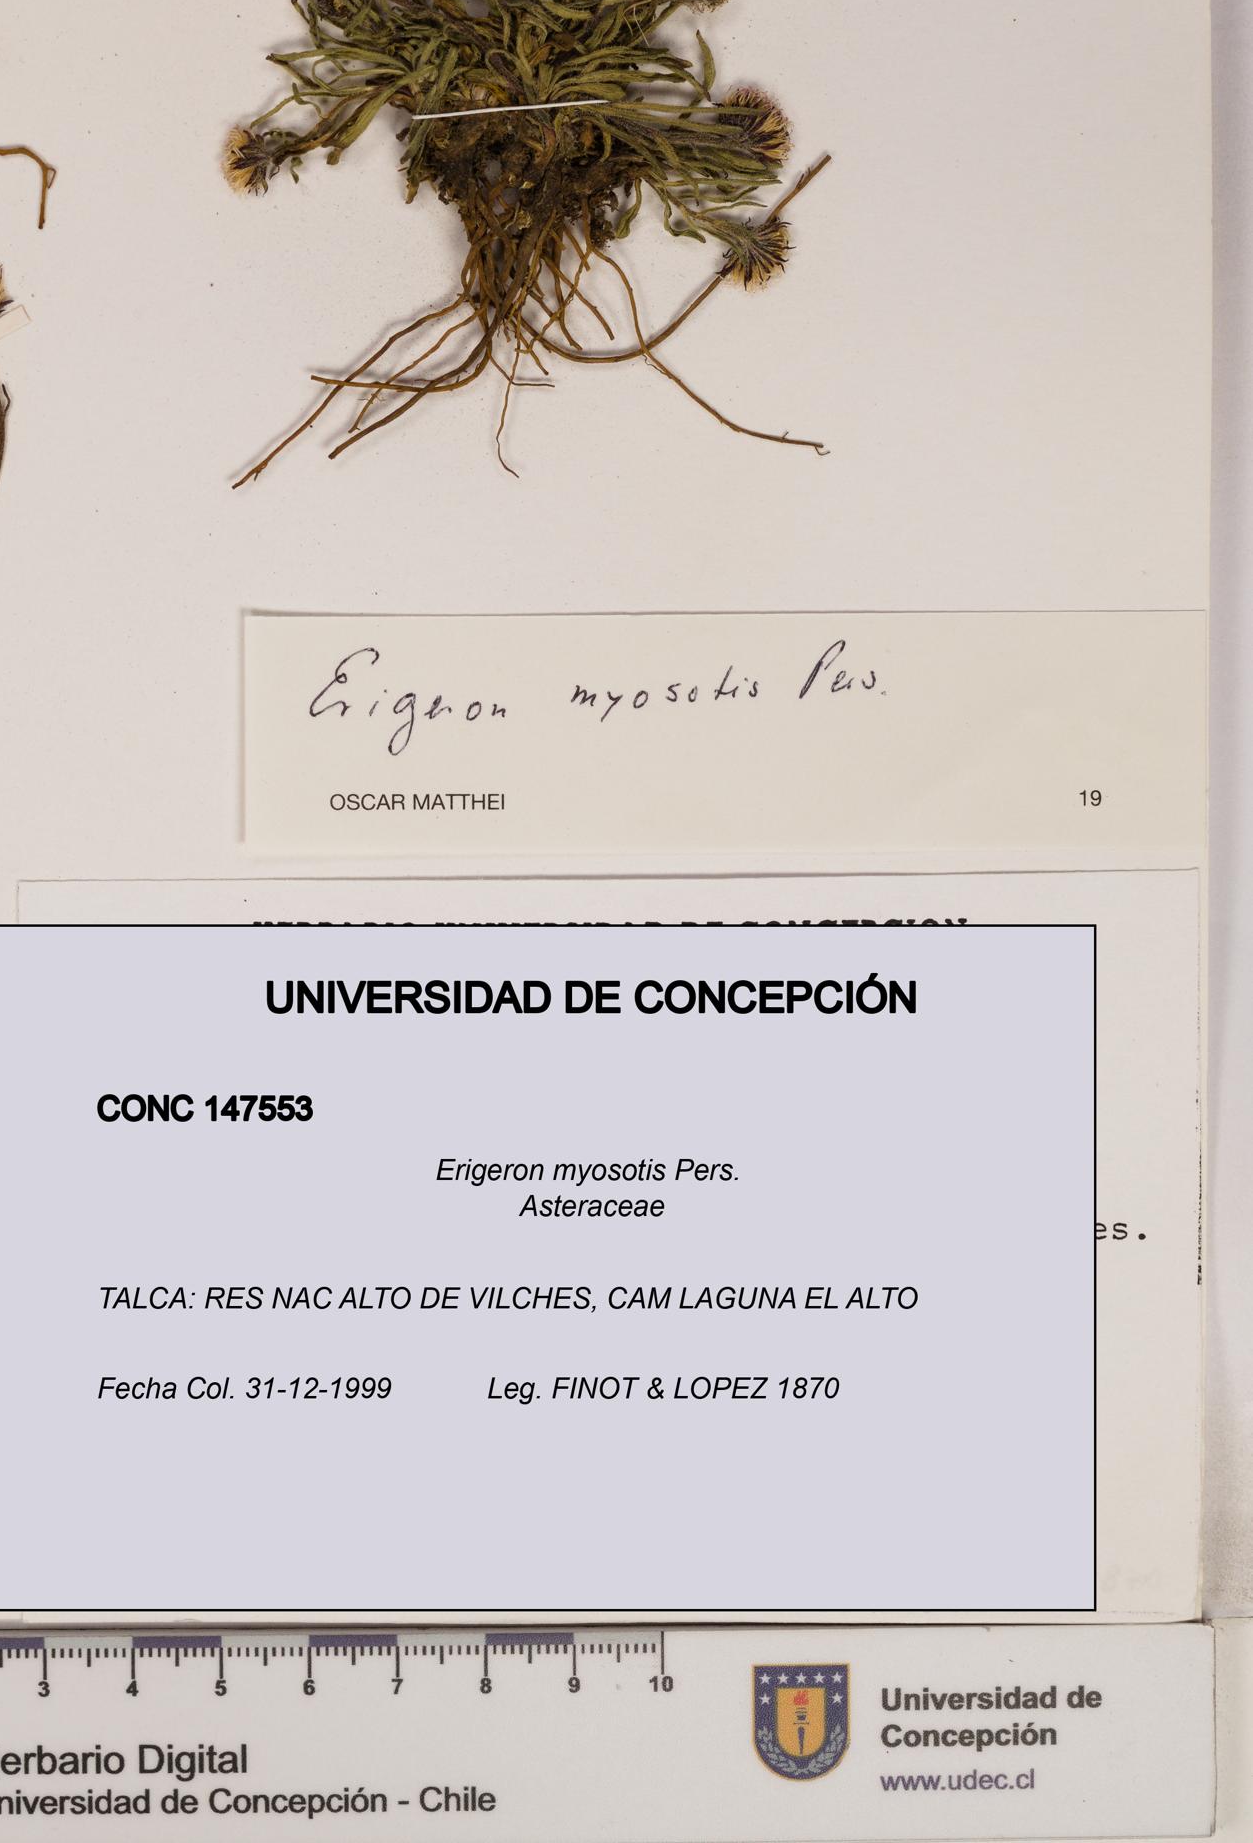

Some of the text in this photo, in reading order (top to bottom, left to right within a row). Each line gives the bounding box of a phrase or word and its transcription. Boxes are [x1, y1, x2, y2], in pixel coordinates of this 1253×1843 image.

[570, 664, 759, 723] myosotis
[329, 793, 505, 812] OSCAR MATTHEI
[1078, 789, 1103, 807] 19
[37, 1681, 51, 1698] 3
[125, 1680, 140, 1697] 4
[213, 1679, 228, 1697] 5
[302, 1679, 316, 1696] 6
[390, 1678, 404, 1695] 7
[479, 1677, 493, 1694] 8
[567, 1676, 581, 1694] 9
[648, 1675, 674, 1693] 10
[881, 1684, 1103, 1712] Universidad de
[880, 1721, 1058, 1753] Concepción
[138, 1743, 248, 1783] Digital
[879, 1767, 1035, 1792] www.udec.cl
[160, 1787, 200, 1815] de
[208, 1786, 388, 1820] Concepción
[418, 1785, 497, 1813] Chile
